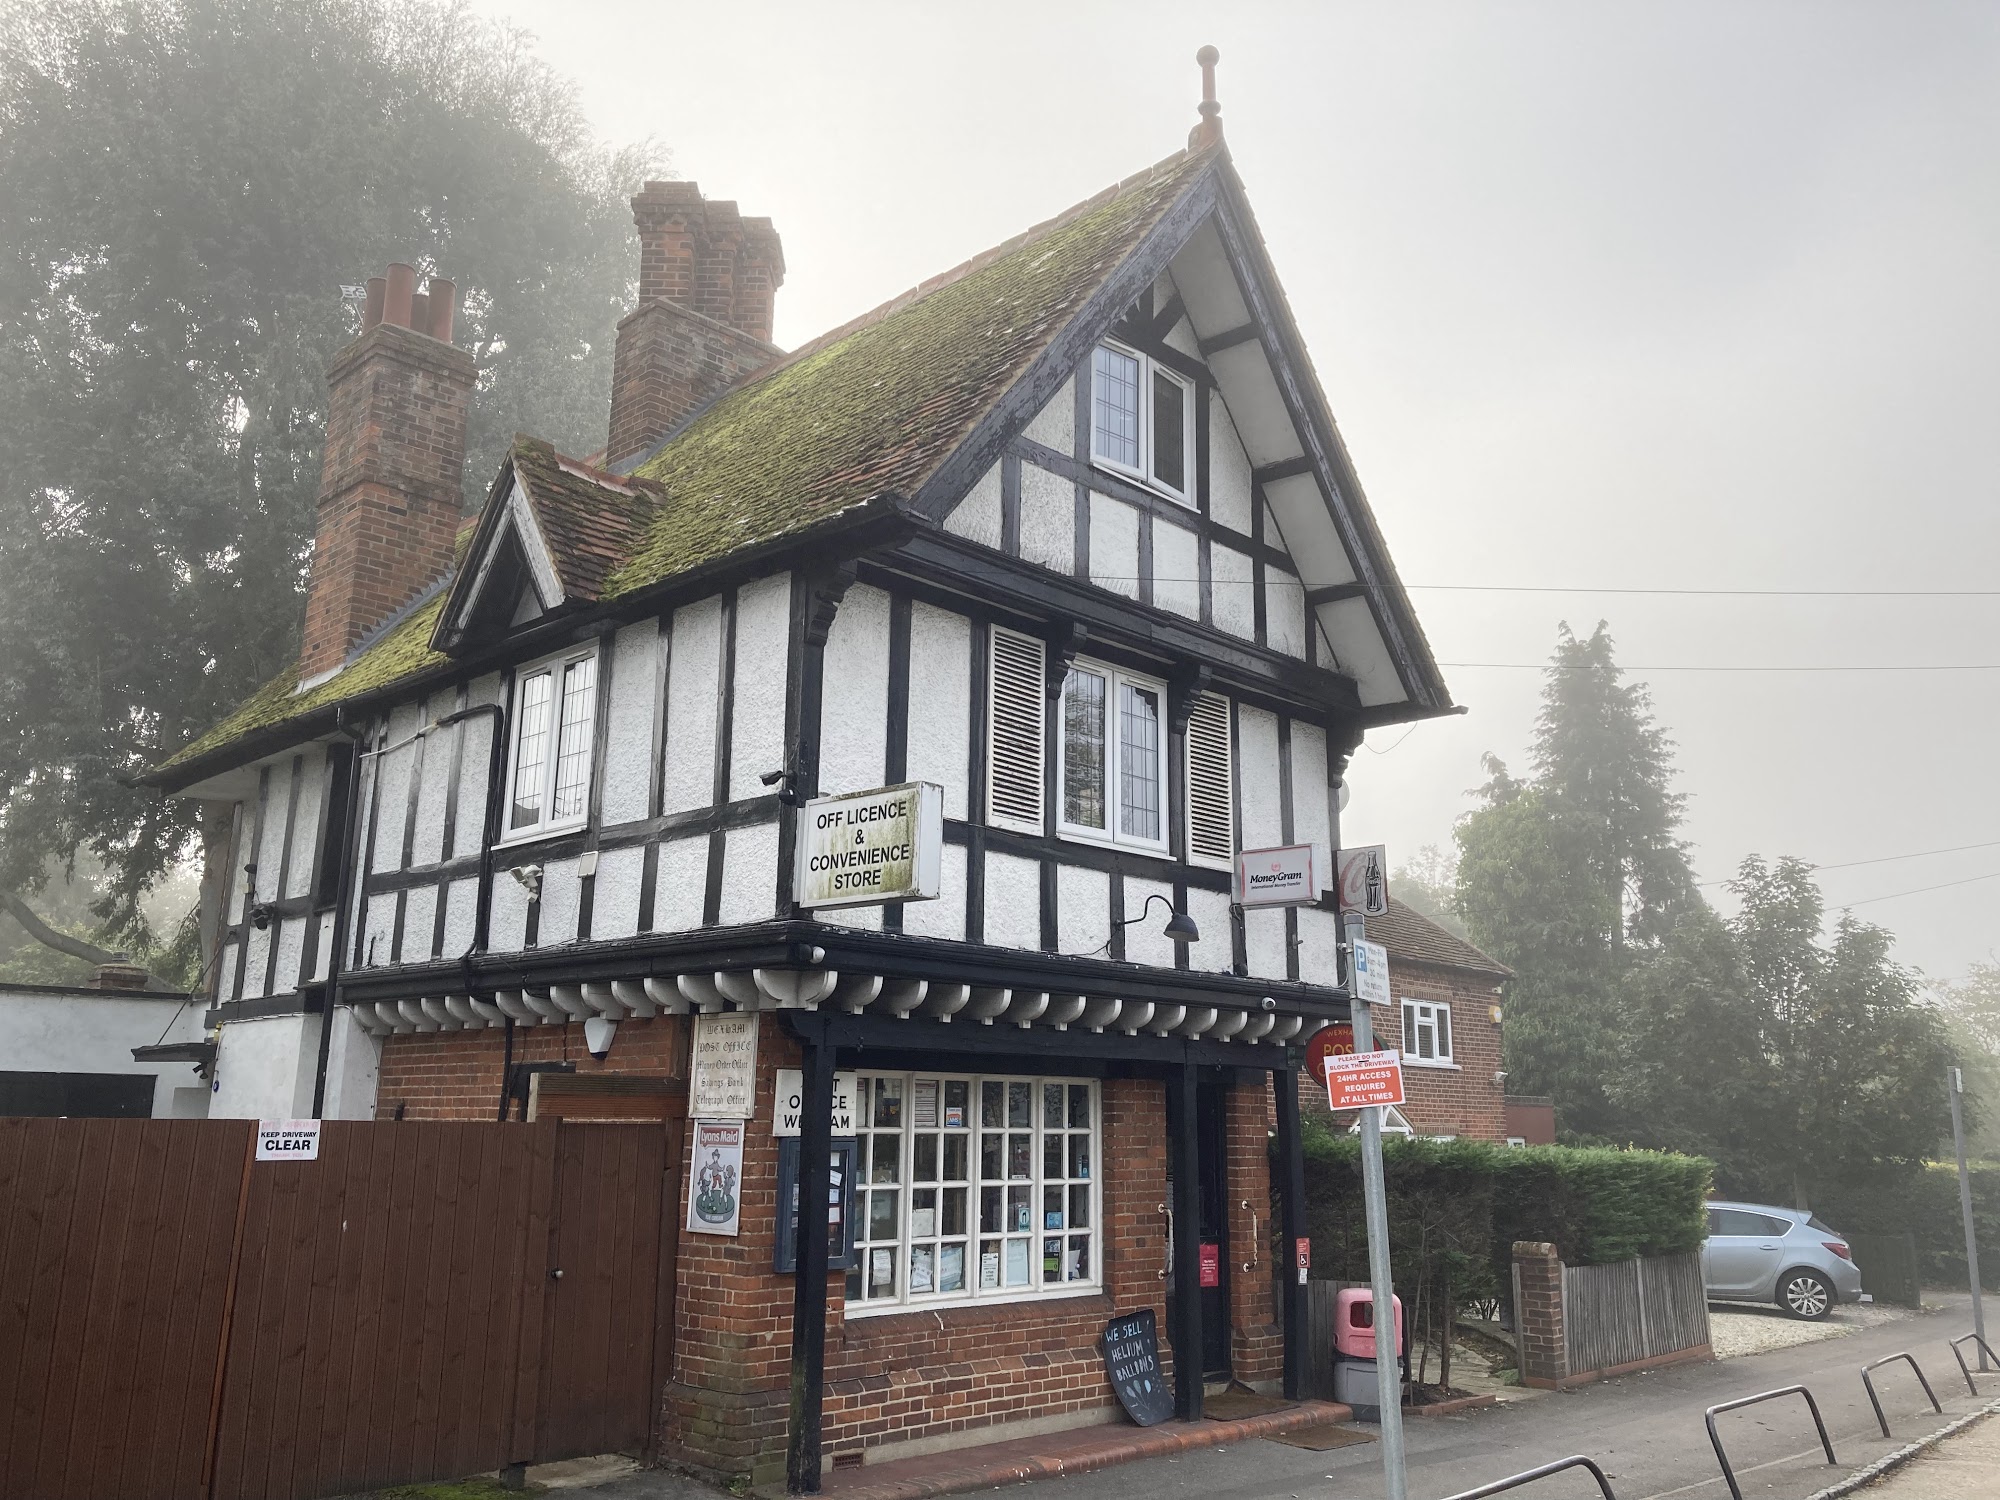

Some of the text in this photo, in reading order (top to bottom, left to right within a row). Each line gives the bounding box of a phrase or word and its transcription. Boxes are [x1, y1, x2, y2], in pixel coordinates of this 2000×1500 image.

[816, 801, 907, 829] OFF LICENCE
[855, 829, 864, 844] &
[810, 844, 910, 871] CONVENIENCE
[834, 869, 881, 889] STORE
[1250, 872, 1302, 883] MoneyGram
[1357, 948, 1365, 969] P
[1327, 1029, 1353, 1037] WEXHA
[1323, 1043, 1353, 1056] POS
[1364, 1059, 1395, 1067] DRIVEWAY
[1337, 1070, 1391, 1083] 24HR ACCESS
[1345, 1082, 1386, 1092] REQUIRED
[696, 1094, 745, 1106] Telegraph Office
[1340, 1092, 1394, 1104] AT ALL TIMES
[701, 1130, 739, 1143] Lyons Maid
[265, 1139, 311, 1151] CLEAR
[1105, 1321, 1142, 1342] WE SELL
[1111, 1339, 1144, 1362] HELIUM
[1115, 1355, 1155, 1381] BALLOONS
